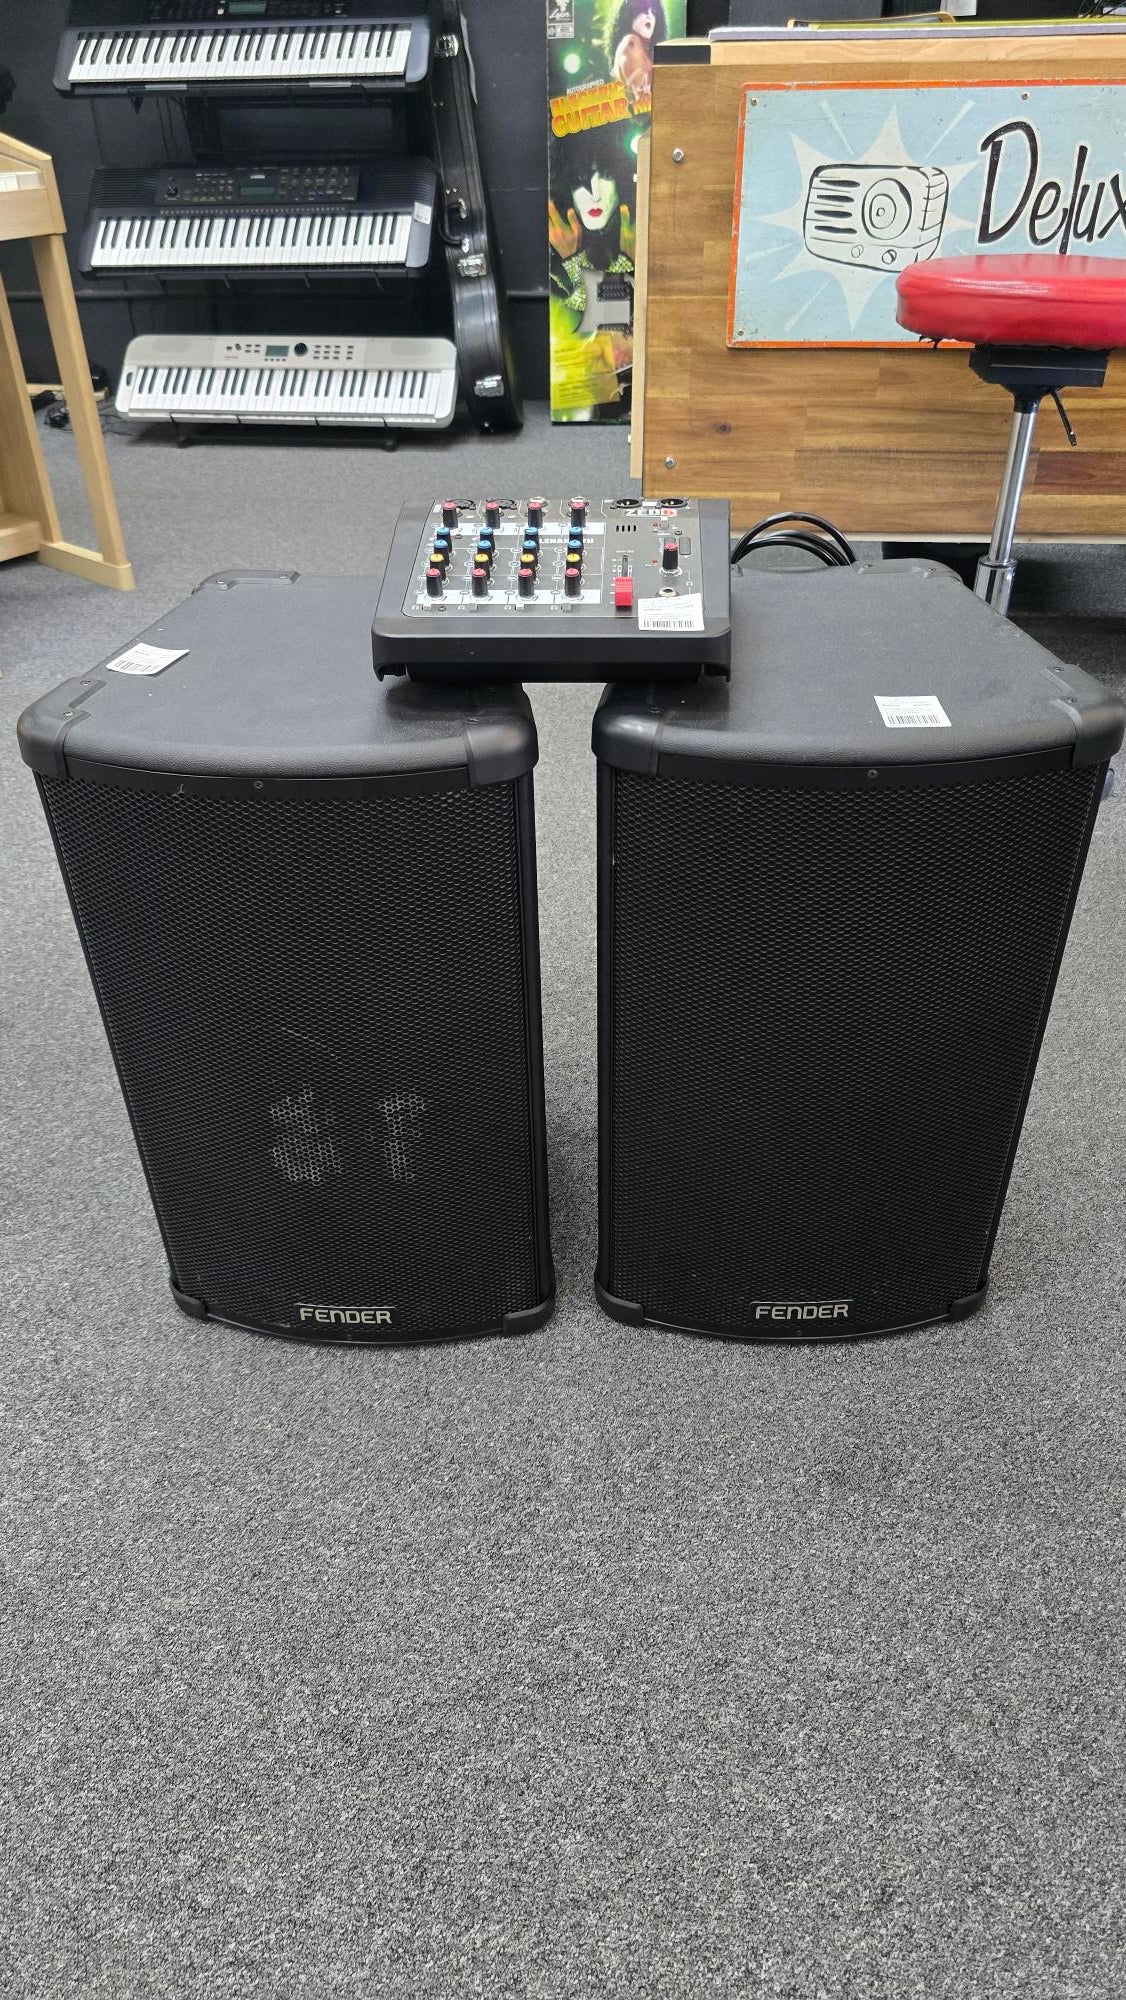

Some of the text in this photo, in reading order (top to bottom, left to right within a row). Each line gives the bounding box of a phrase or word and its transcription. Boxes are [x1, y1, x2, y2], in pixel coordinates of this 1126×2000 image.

[550, 81, 626, 117] ELECTRIC
[552, 98, 632, 137] GUITAR
[300, 1307, 392, 1324] FENDER
[755, 1304, 849, 1320] FENDER
